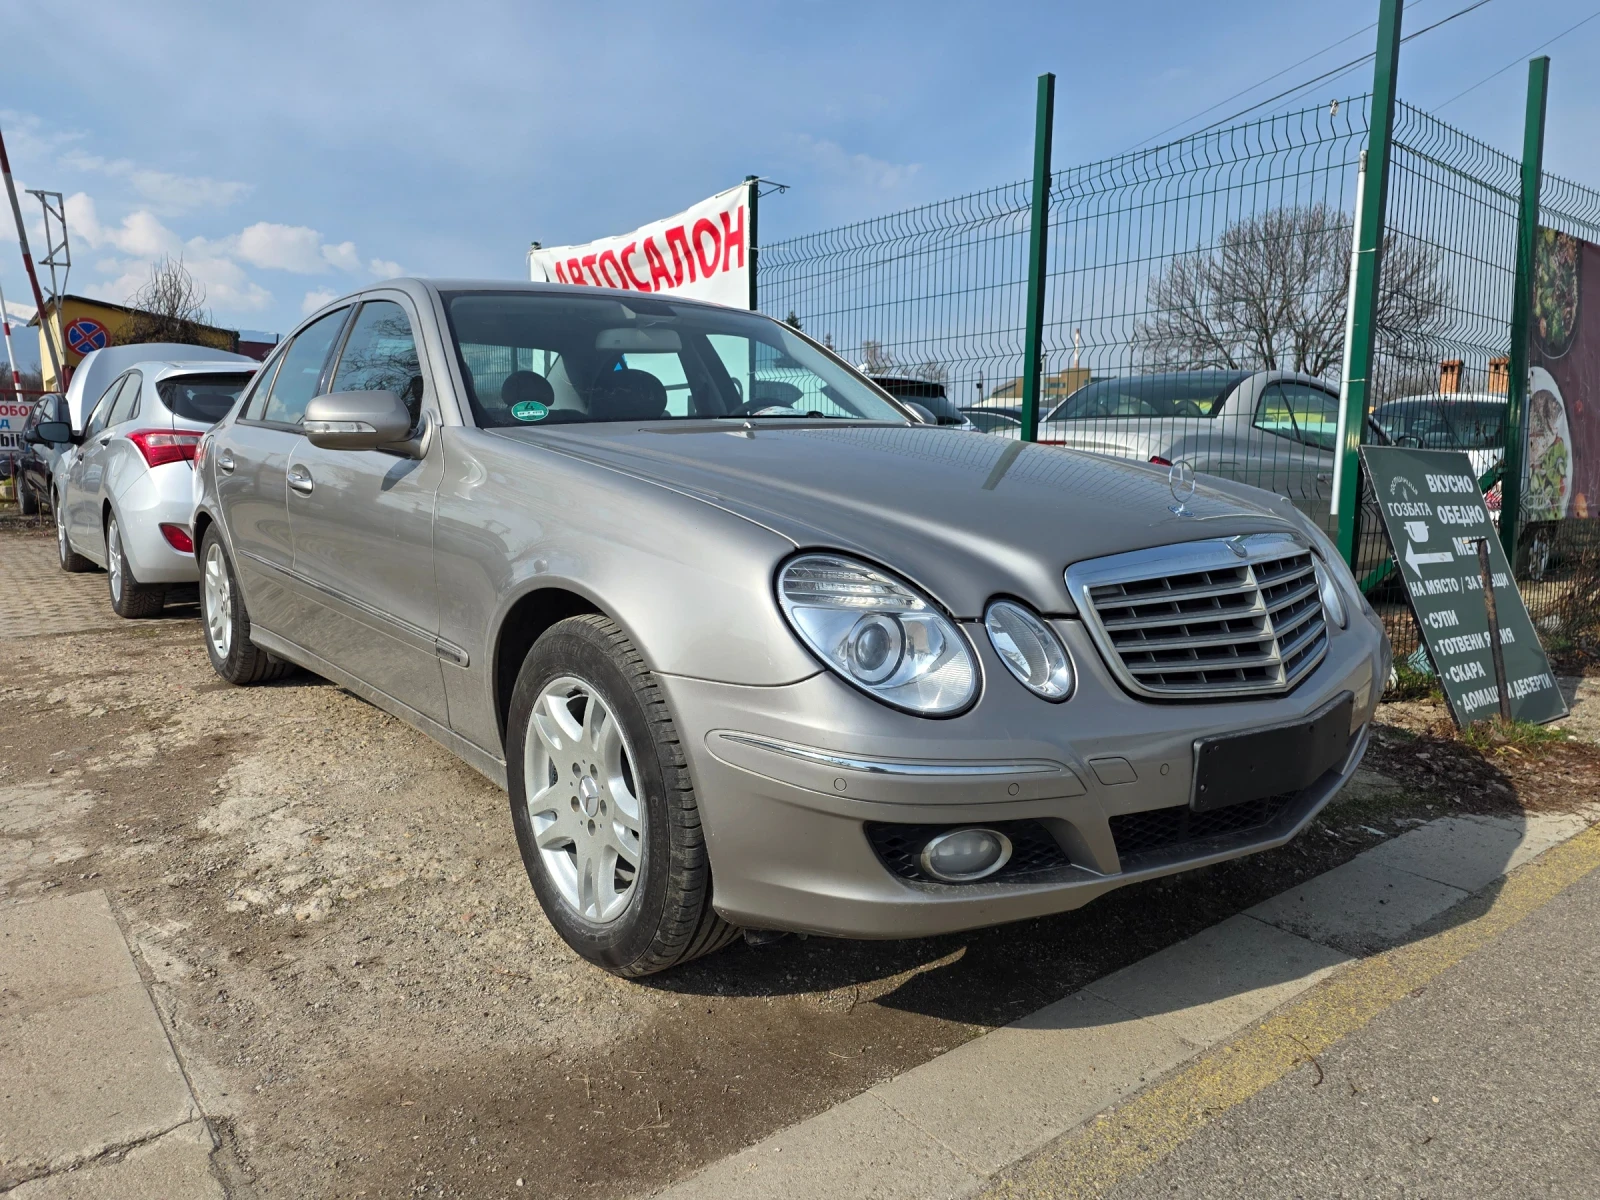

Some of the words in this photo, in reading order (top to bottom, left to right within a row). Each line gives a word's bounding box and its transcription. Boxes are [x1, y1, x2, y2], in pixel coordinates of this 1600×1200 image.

[1425, 474, 1474, 493] ВКУСНО
[1387, 502, 1433, 517] ГОЗБАТА
[1437, 505, 1485, 527] ОБЕДНО
[1409, 581, 1426, 597] НА
[1424, 577, 1459, 595] МЯСТО
[1465, 575, 1479, 590] ЗА
[1477, 572, 1509, 589] ВЩИ
[1428, 609, 1460, 629] СУПИ
[1438, 632, 1485, 656] ГОТВЕНИ
[1483, 627, 1515, 648] ЯИЯ
[1449, 661, 1486, 683] СКАРА
[1461, 682, 1515, 714] ДОМАШИ
[1513, 672, 1553, 700] ДЕСЕРТИ
